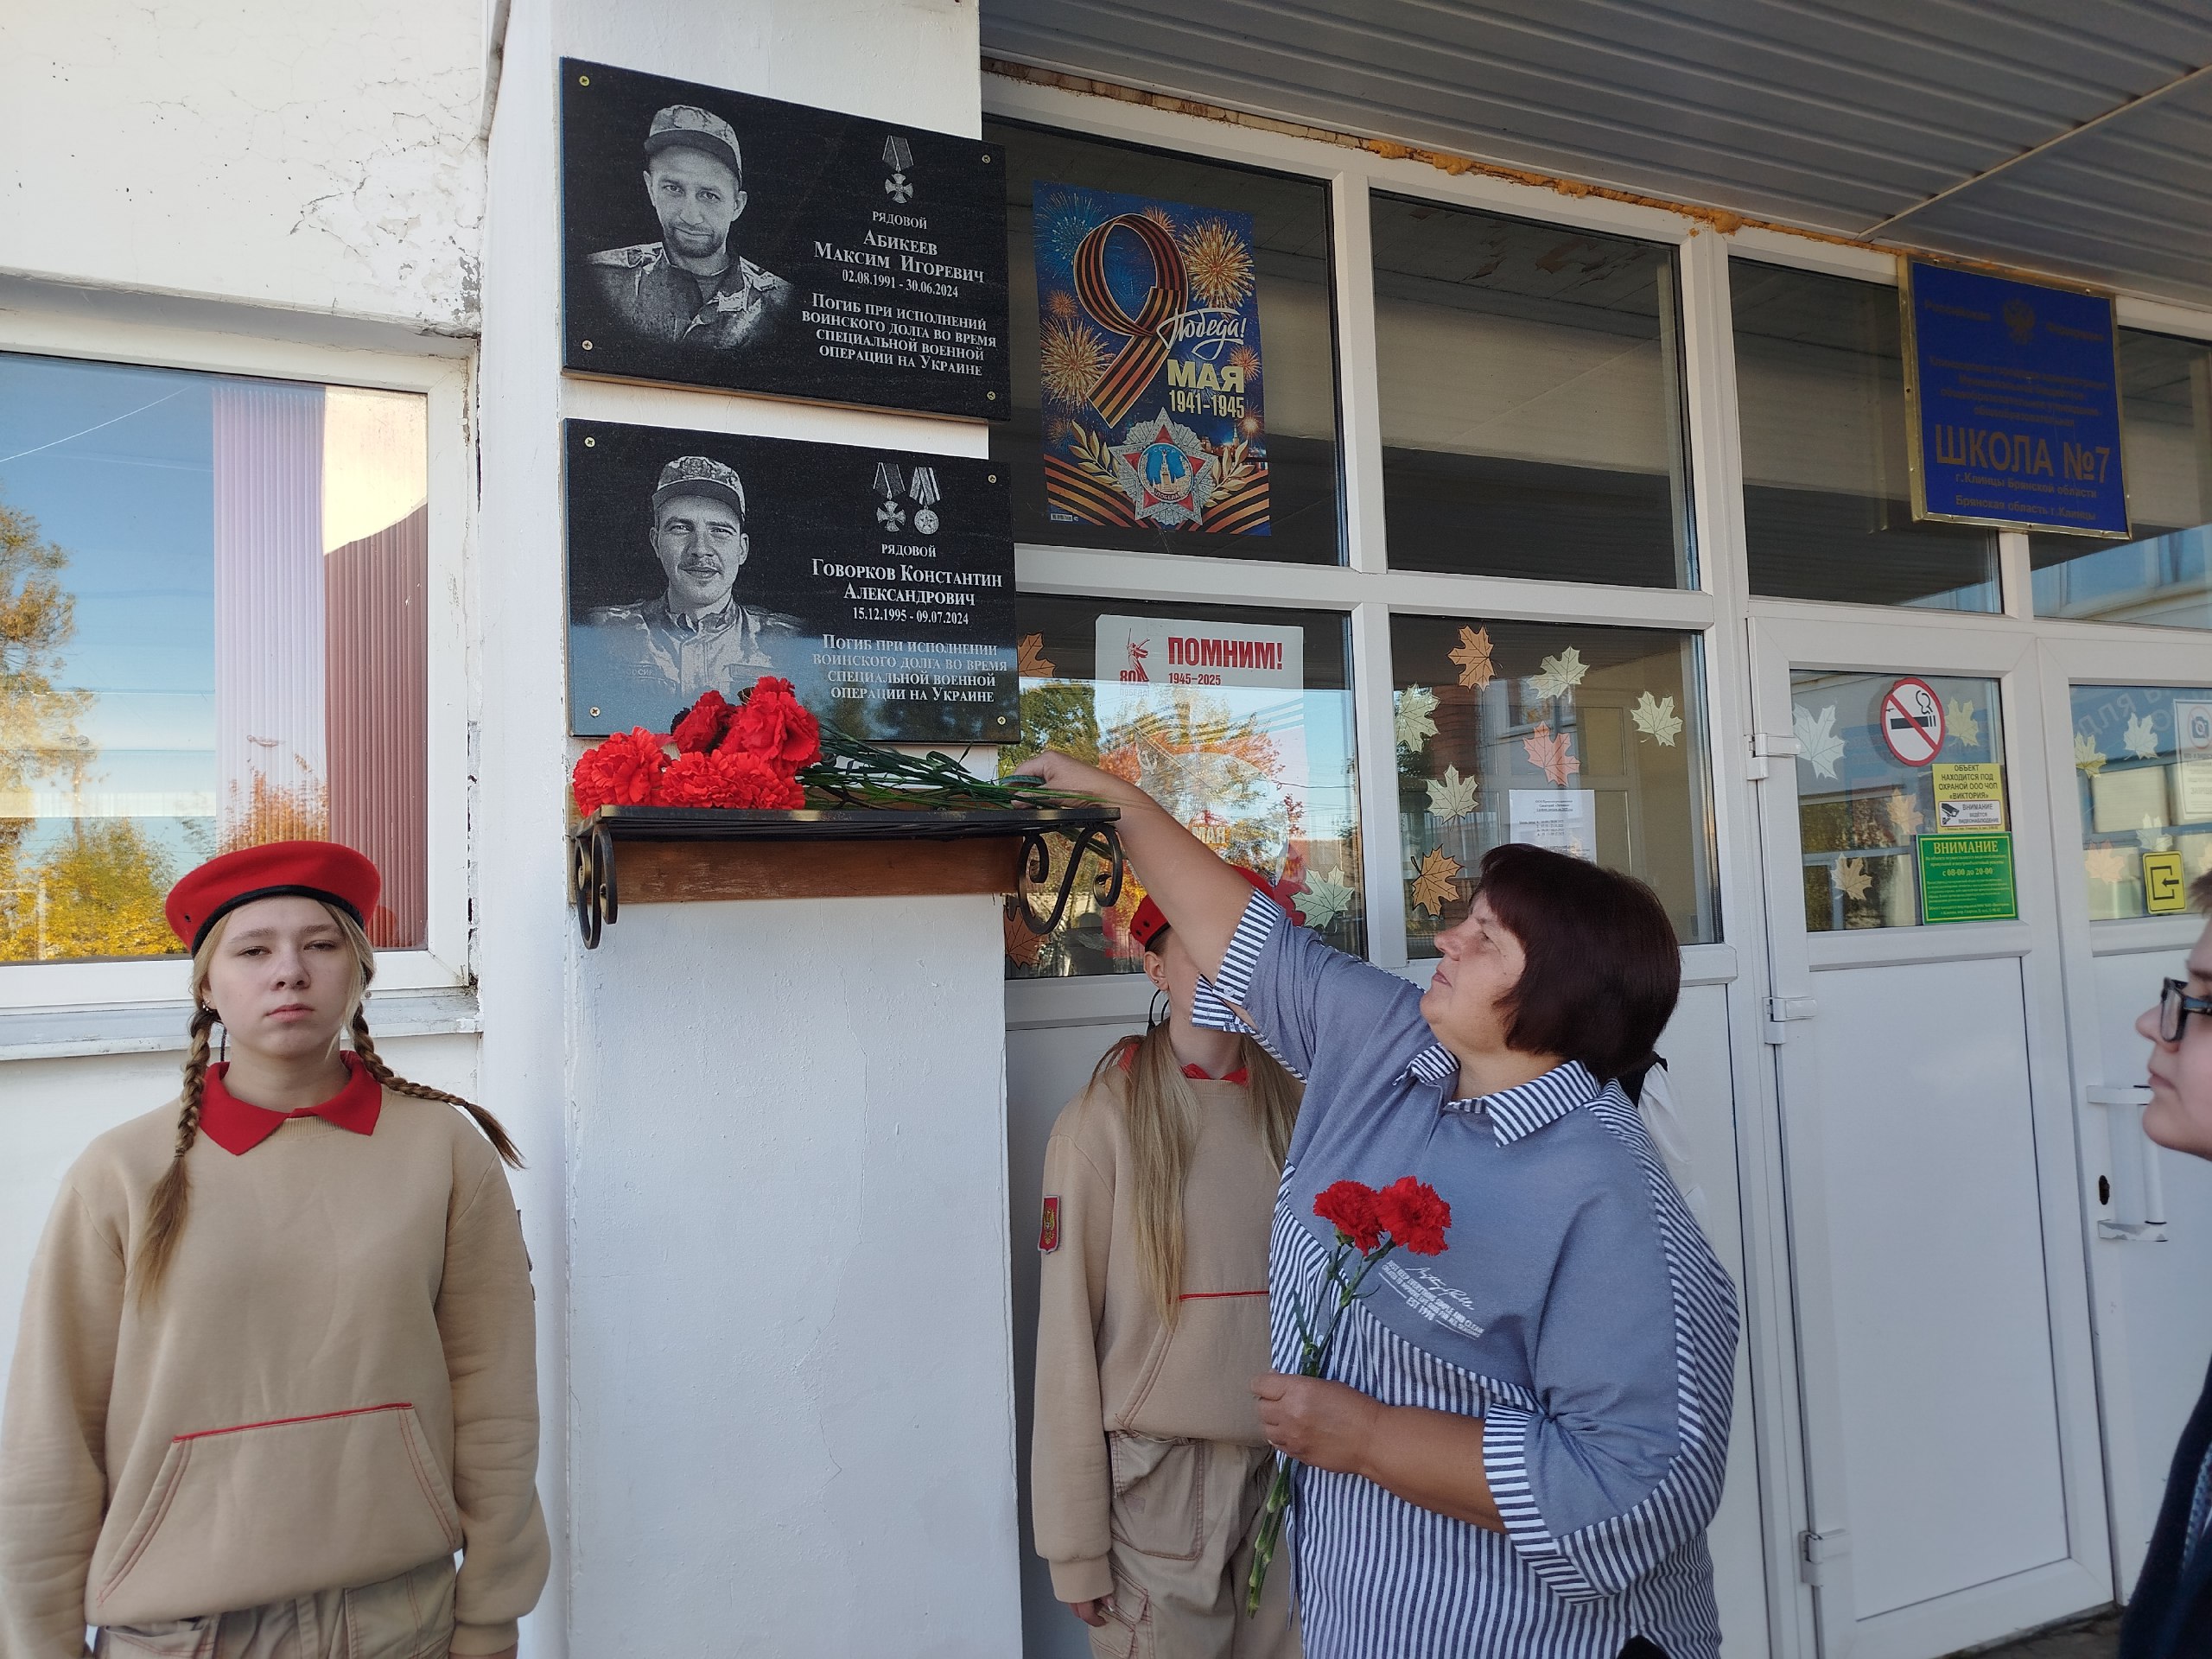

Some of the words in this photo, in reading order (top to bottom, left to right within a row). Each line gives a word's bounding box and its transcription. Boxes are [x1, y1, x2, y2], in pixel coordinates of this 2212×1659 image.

[872, 211, 929, 230] РЯДОВОЙ
[863, 229, 938, 256] АБИКЕЕВ
[813, 241, 891, 269] МАКСИМ
[900, 255, 985, 283] ИГОРЕВИЧ
[842, 269, 896, 289] 02.08.1991
[906, 278, 959, 298] 30.06.2024
[812, 292, 862, 313] ПОГИБ
[865, 303, 893, 318] ПРИ
[801, 310, 886, 333] ВОИНСКОГО
[888, 323, 930, 340] ДОЛГА
[933, 329, 951, 341] ВО
[955, 331, 997, 347] ВРЕМЯ
[1156, 308, 1247, 361] Победа!
[816, 328, 918, 353] СПЕЦИАЛЬНОЙ
[921, 342, 985, 360] ВОЕННОЙ
[818, 345, 893, 365] ОПЕРАЦИИ
[897, 355, 917, 368] НА
[919, 354, 983, 376] УКРАИНЕ
[1166, 359, 1245, 394] МАЯ
[1168, 389, 1245, 419] 1941-1945
[1935, 423, 2055, 477] ШКОЛА
[2063, 442, 2111, 484] №7
[1955, 472, 2005, 488] г.Клинцы
[2007, 477, 2055, 493] Брянской
[2057, 485, 2097, 499] области
[1955, 494, 2005, 511] Брянская
[2008, 500, 2047, 515] область
[881, 543, 937, 558] РЯДОВОЙ
[811, 558, 896, 582] ГОВОРКОВ
[899, 564, 1003, 588] КОНСТАНТИН
[843, 582, 976, 607] АЛЕКСАНДРОВИЧ
[852, 607, 907, 622] 15.12.1995
[916, 610, 969, 626] 09.07.2024
[823, 633, 873, 651] ПОГИБ
[875, 639, 904, 652] ПРИ
[907, 641, 998, 656] ИСПОЛНЕНИИ
[1167, 636, 1283, 671] ПОМНИМ!
[812, 653, 897, 669] ВОИНСКОГО
[900, 657, 942, 671] ДОЛГА
[944, 658, 963, 671] ВО
[966, 659, 1007, 672] ВРЕМЯ
[827, 670, 930, 686] СПЕЦИАЛЬНОЙ
[932, 672, 996, 687] ВОЕННОЙ
[1168, 672, 1222, 686] 1945-2025
[830, 686, 906, 702] ОПЕРАЦИИ
[910, 689, 928, 701] НА
[932, 687, 995, 702] УКРАИНЕ
[1938, 782, 1968, 791] ОХРАНОЙ
[1192, 826, 1225, 844] МАЯ
[1933, 840, 1999, 855] ВНИМАНИЕ
